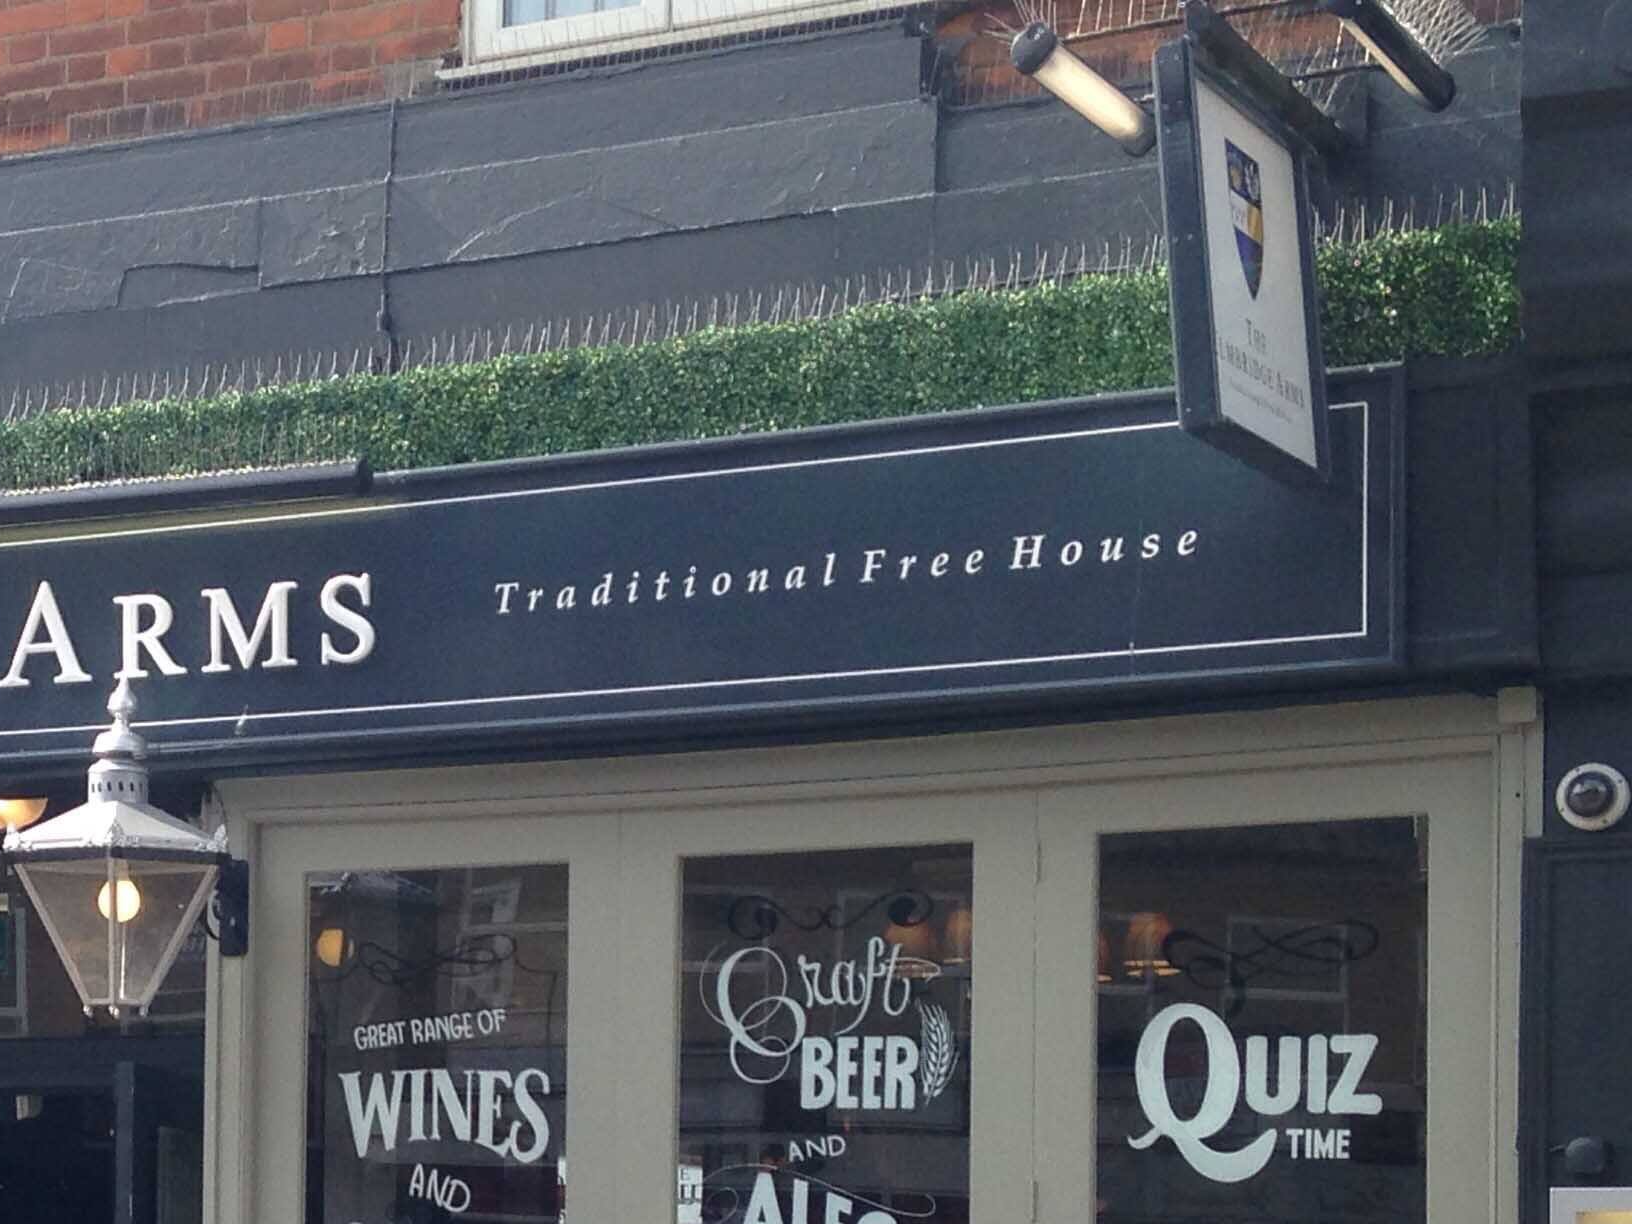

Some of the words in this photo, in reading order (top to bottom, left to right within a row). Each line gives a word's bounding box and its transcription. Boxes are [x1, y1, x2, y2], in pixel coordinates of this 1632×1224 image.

[494, 551, 838, 615] Traditional
[858, 547, 985, 585] Free
[1007, 528, 1199, 570] House
[353, 1020, 406, 1051] GREAT
[410, 1012, 473, 1045] RANGE
[477, 1008, 507, 1034] OF
[699, 937, 943, 1084] Craft
[799, 1036, 921, 1110] BEER
[1127, 1002, 1384, 1183] QUIZ
[338, 1067, 551, 1164] WINES
[787, 1134, 847, 1164] AND
[1285, 1127, 1352, 1160] TIME
[409, 1163, 471, 1213] AND
